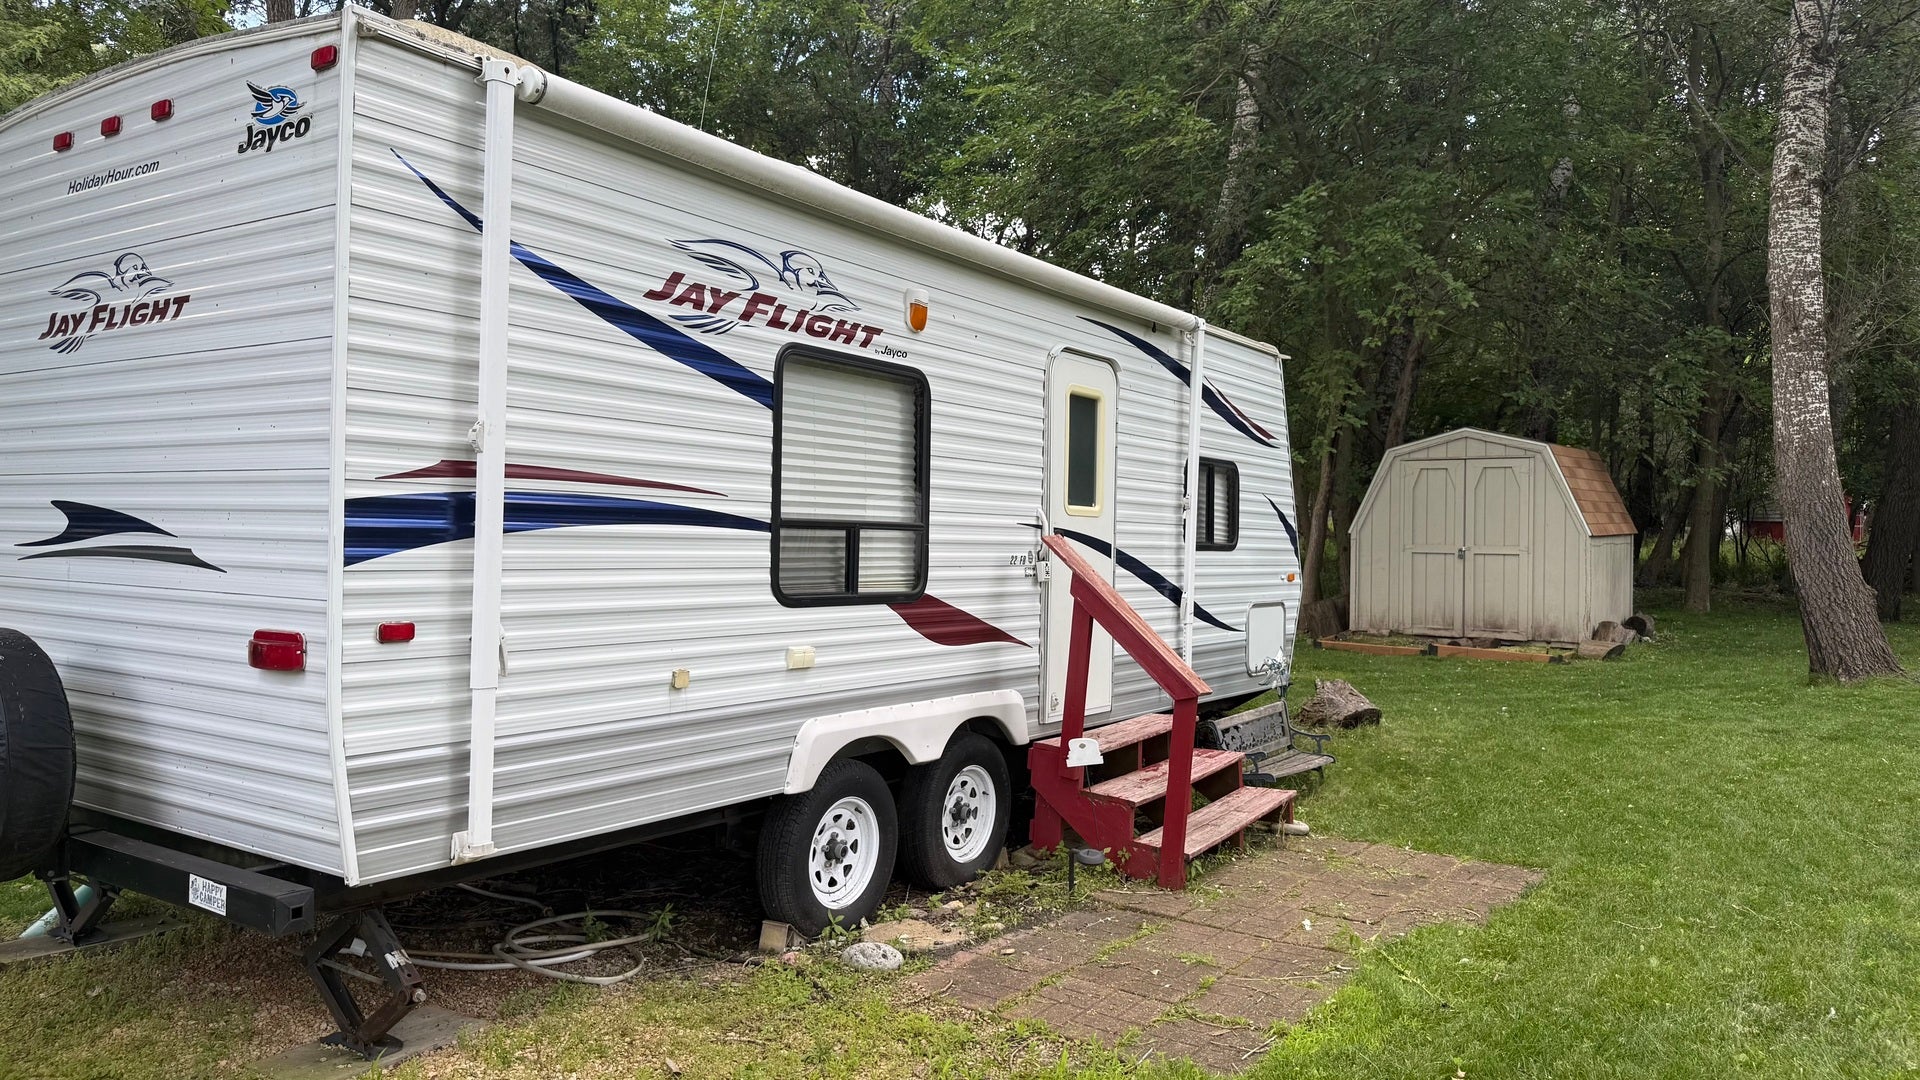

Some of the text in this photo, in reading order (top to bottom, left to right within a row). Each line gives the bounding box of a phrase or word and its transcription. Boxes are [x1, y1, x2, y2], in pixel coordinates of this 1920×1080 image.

[238, 115, 312, 154] Jayco
[67, 160, 160, 195] HolidayHour.com
[38, 295, 191, 341] JAY FLIGHT
[642, 271, 884, 349] JAY FLIGHT
[881, 345, 908, 359] Jayco
[1009, 555, 1018, 565] 22
[199, 891, 226, 910] CAMPER
[202, 880, 224, 898] HAPPY
